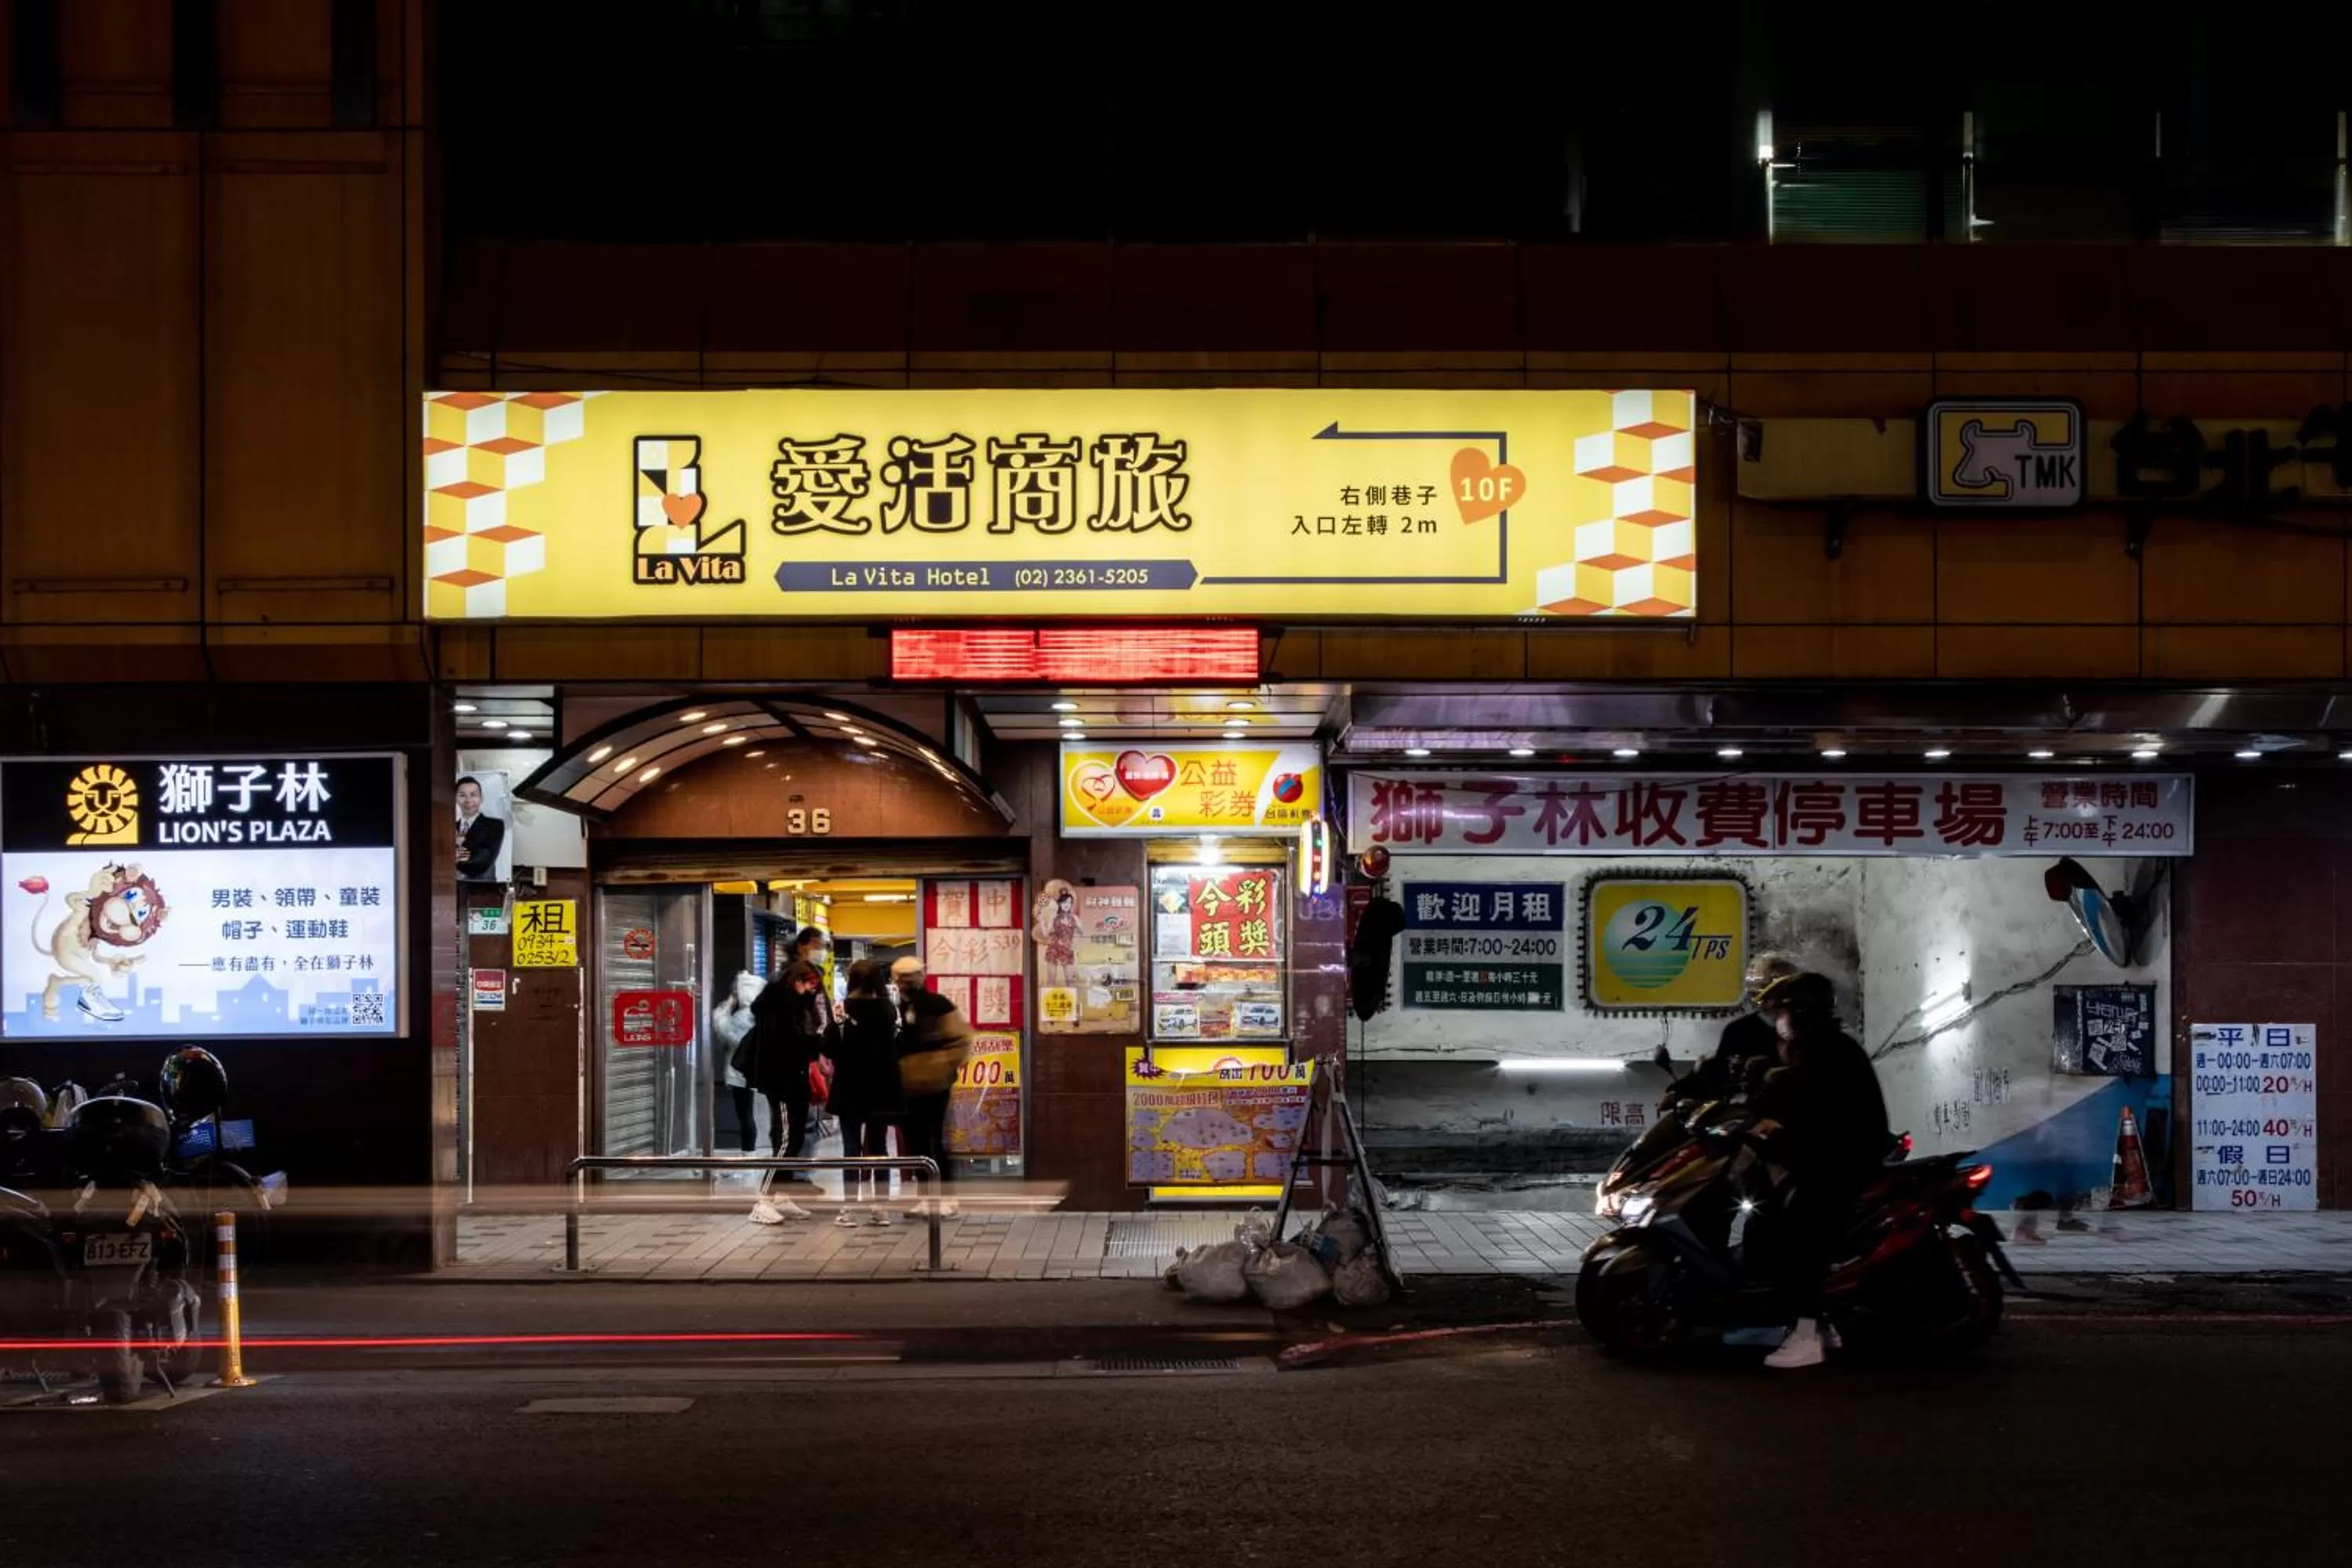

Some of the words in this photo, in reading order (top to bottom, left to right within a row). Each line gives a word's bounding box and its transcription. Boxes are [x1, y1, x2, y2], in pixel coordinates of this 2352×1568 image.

[770, 432, 1192, 535] 愛活商旅
[2014, 454, 2078, 489] TMK
[1340, 485, 1438, 506] 右側巷子
[1460, 476, 1513, 502] 10F
[1290, 514, 1388, 535] 入口左轉
[1400, 514, 1438, 535] 2m
[927, 566, 991, 586] Hotel
[1014, 567, 1049, 588] (02)
[1054, 568, 1149, 586] 2361-5205
[1180, 759, 1238, 787] 公益
[159, 762, 332, 814] 獅子林
[2040, 781, 2158, 810] 營業時間
[1199, 789, 1256, 818] 彩券
[1370, 779, 2008, 848] 獅子林收費停車場
[159, 819, 242, 844] LION'S
[250, 818, 332, 842] PLAZA
[787, 808, 831, 833] 36
[211, 886, 382, 909] 男裝、領帶、童裝
[1196, 877, 1268, 916] 今彩
[1416, 891, 1552, 922] 歡迎月租
[222, 919, 349, 940] 帽子、運動鞋
[521, 903, 571, 934] 租
[1623, 905, 1698, 952] 24
[1199, 919, 1270, 957] 頭獎
[2217, 1028, 2290, 1047] 平日
[1601, 1101, 1644, 1126] 限高
[2217, 1145, 2290, 1164] 假日
